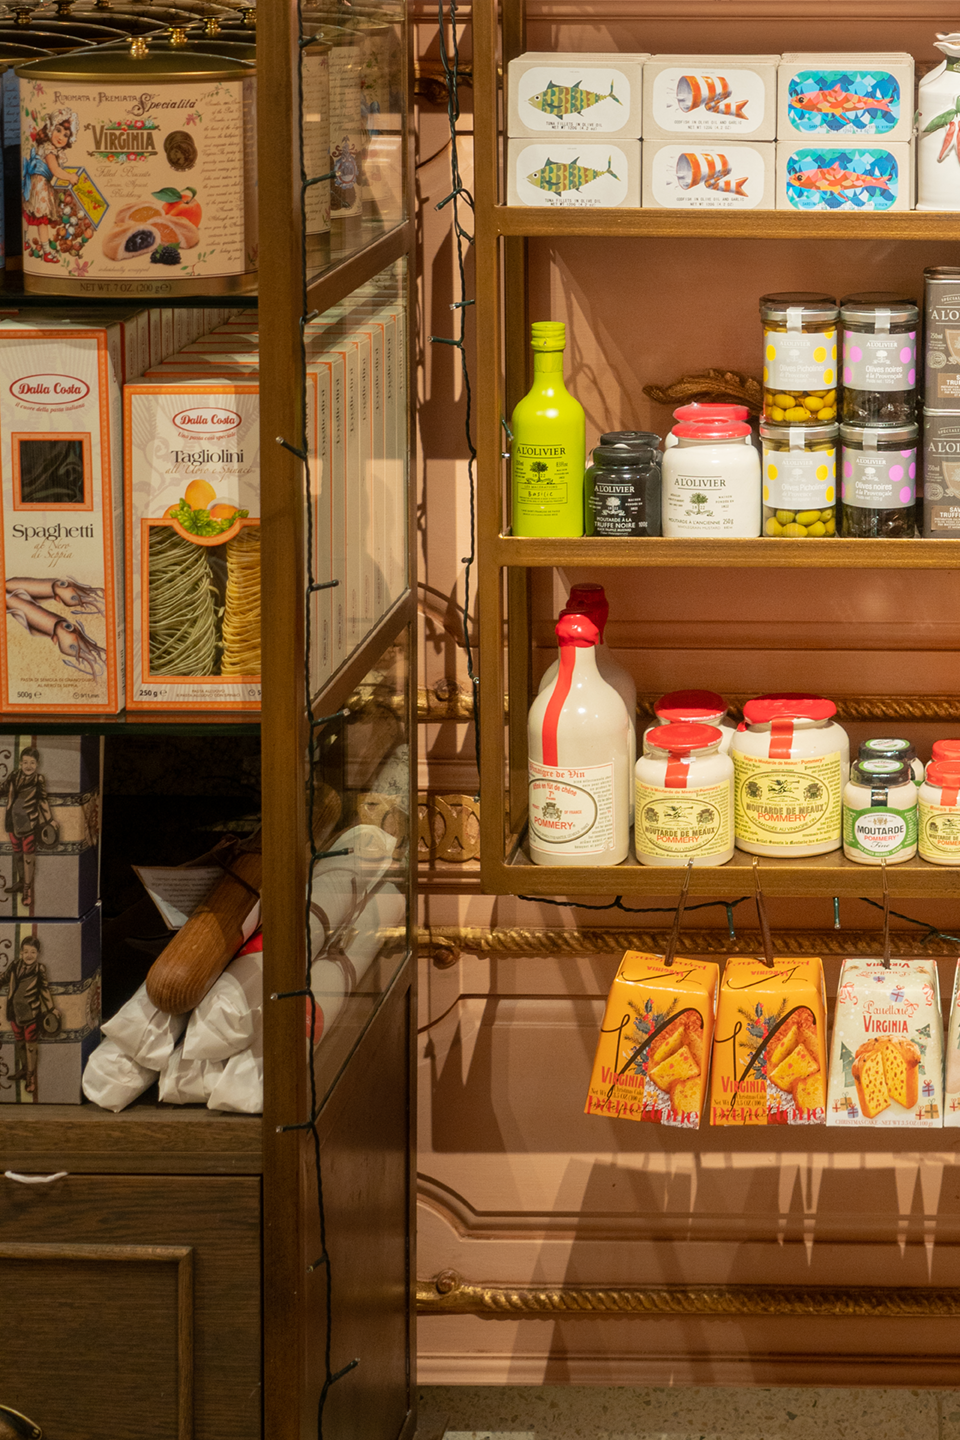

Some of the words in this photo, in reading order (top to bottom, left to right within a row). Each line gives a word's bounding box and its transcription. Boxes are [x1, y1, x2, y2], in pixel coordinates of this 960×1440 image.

[91, 125, 156, 150] VIRGINIA
[80, 283, 97, 292] NET
[114, 284, 119, 292] 7
[18, 382, 51, 395] Dalla
[53, 382, 82, 395] Costa
[180, 415, 208, 425] Dalla
[211, 414, 235, 425] Costa
[171, 449, 244, 466] Tagliolini
[521, 447, 566, 456] L'OLIVIER
[681, 478, 726, 487] L'OLIVIER
[12, 523, 94, 541] Spaghetti
[17, 691, 32, 699] 500g
[746, 803, 785, 815] MOUTARDE
[786, 807, 796, 815] DE
[798, 805, 823, 814] MEAUX
[534, 816, 573, 830] POMMERY
[757, 812, 807, 823] POMMERY
[645, 826, 678, 837] MOUTARDE
[680, 830, 690, 838] DE
[692, 827, 715, 837] MEAUX
[857, 825, 904, 835] MOUTARDE
[657, 835, 700, 843] POMMERY
[863, 1016, 909, 1033] VIRGINIA
[601, 1066, 644, 1089] VIRGINIA
[721, 1076, 766, 1093] VIRGINIA
